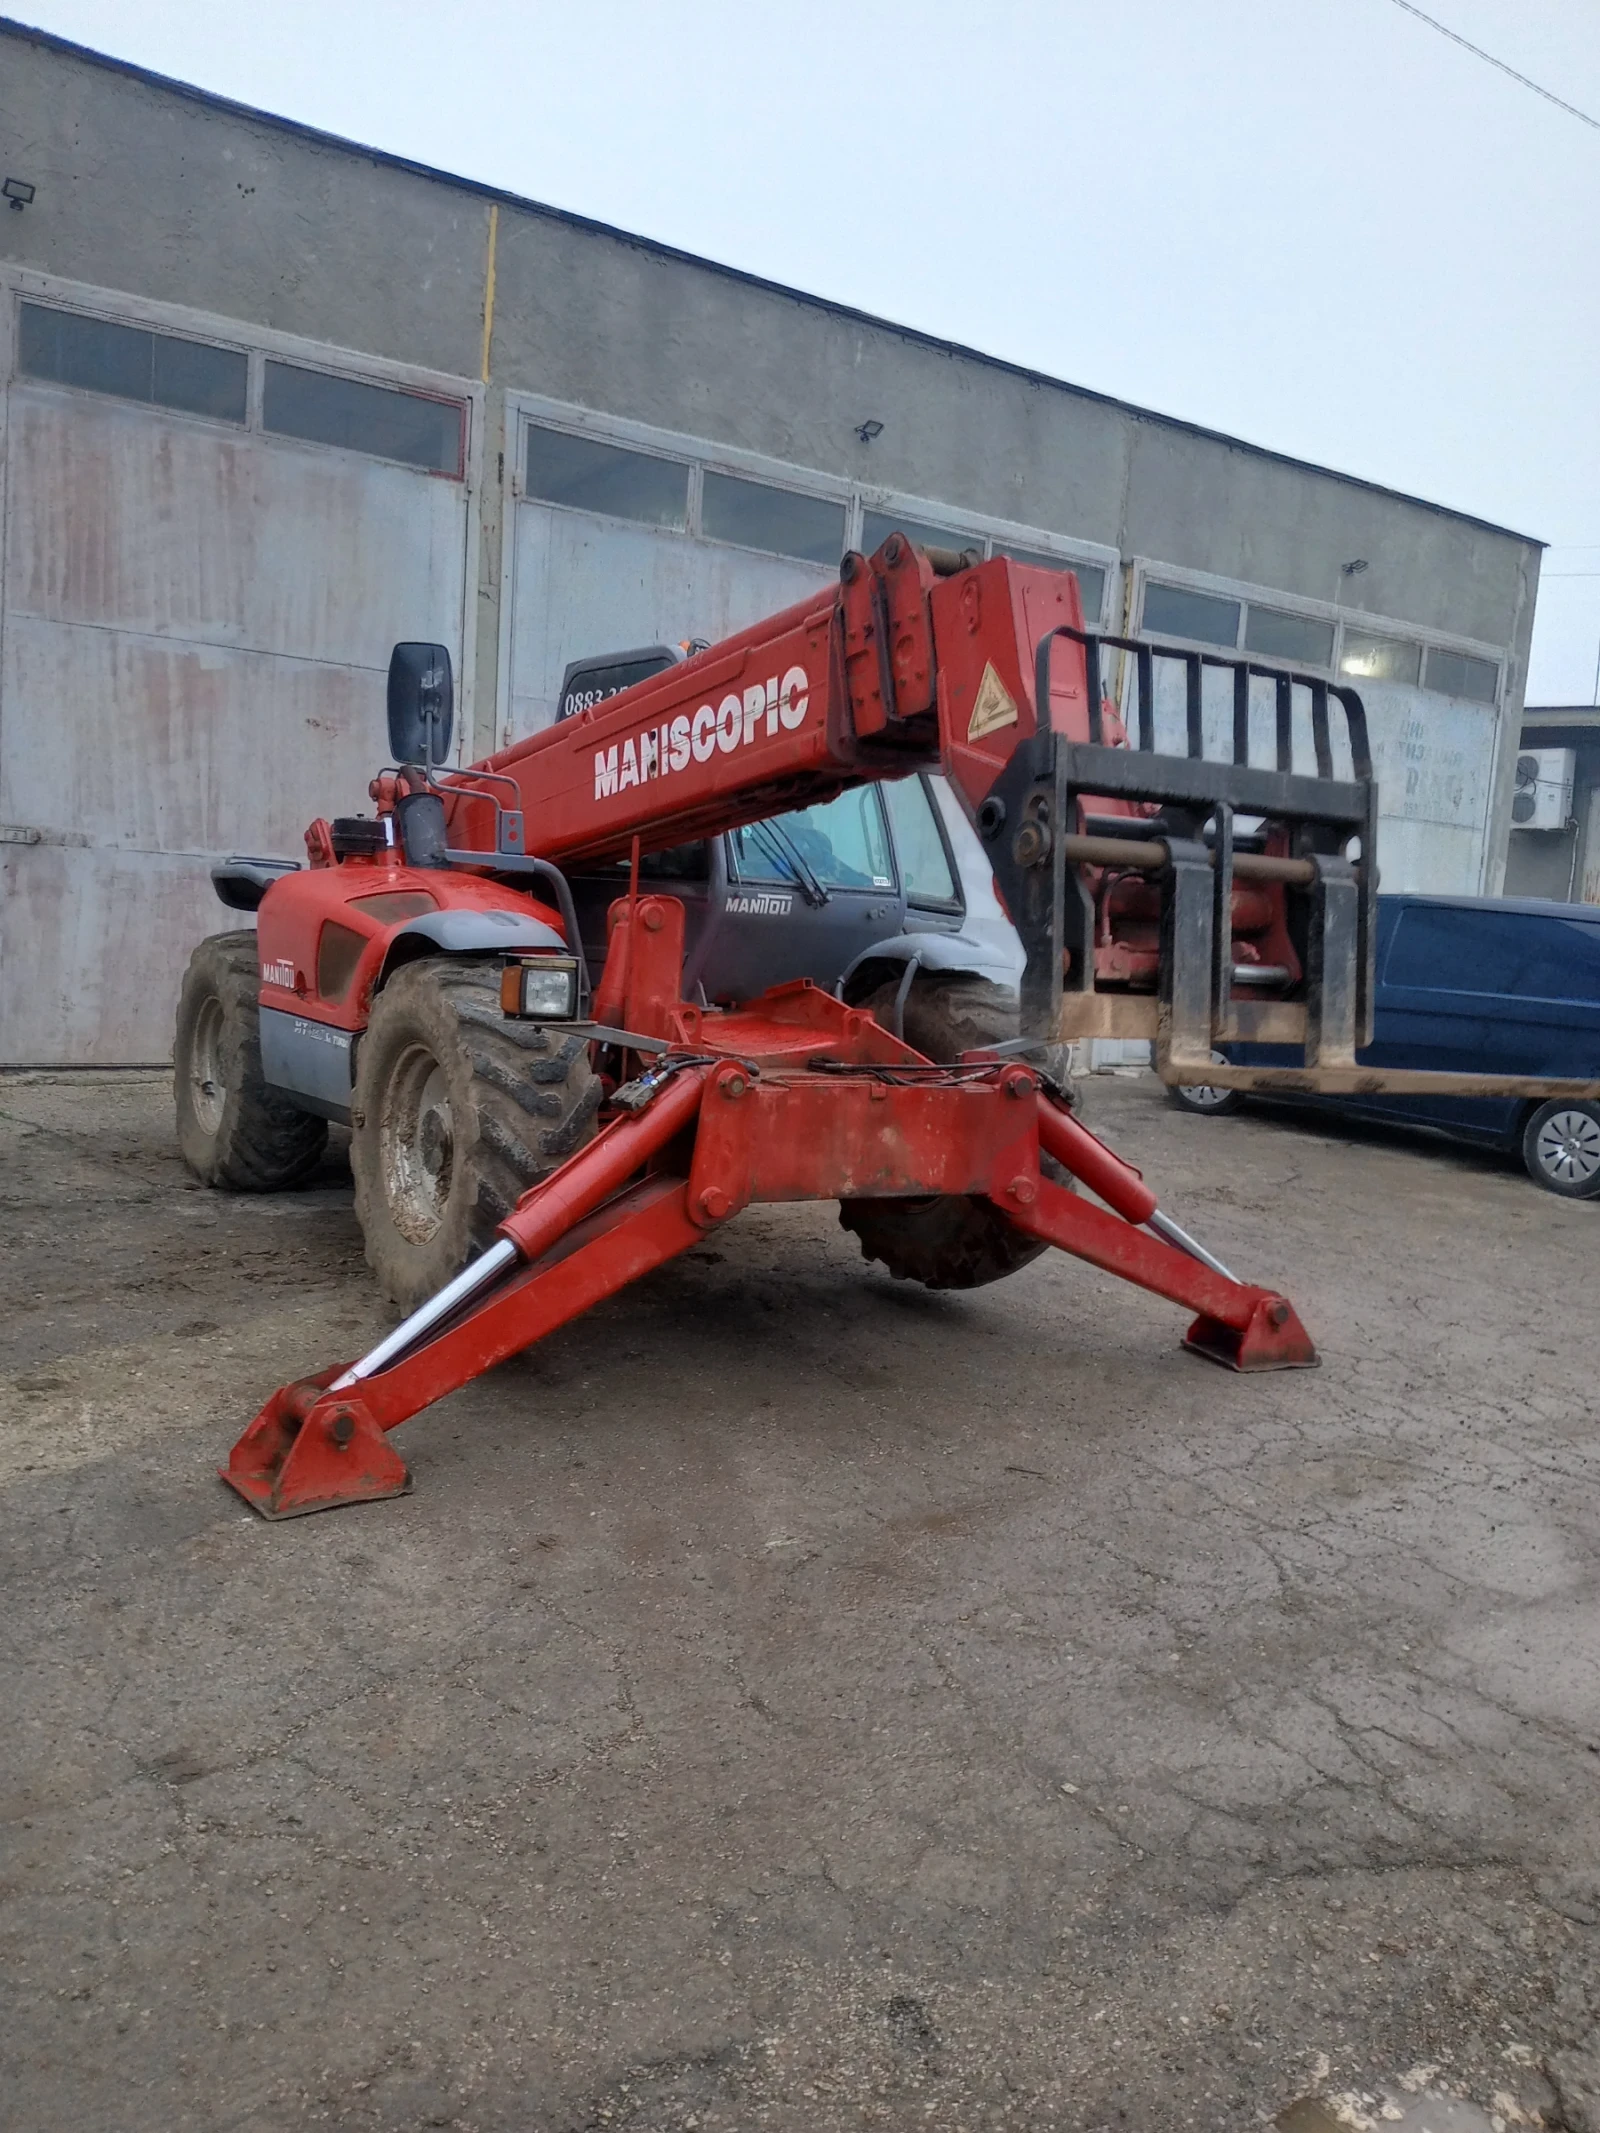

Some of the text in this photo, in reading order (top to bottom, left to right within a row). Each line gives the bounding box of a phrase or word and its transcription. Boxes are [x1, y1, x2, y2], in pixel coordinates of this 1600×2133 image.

[594, 666, 810, 801] MANISCOPIC
[725, 893, 793, 916] MANITOU
[263, 958, 295, 989] MANITOU
